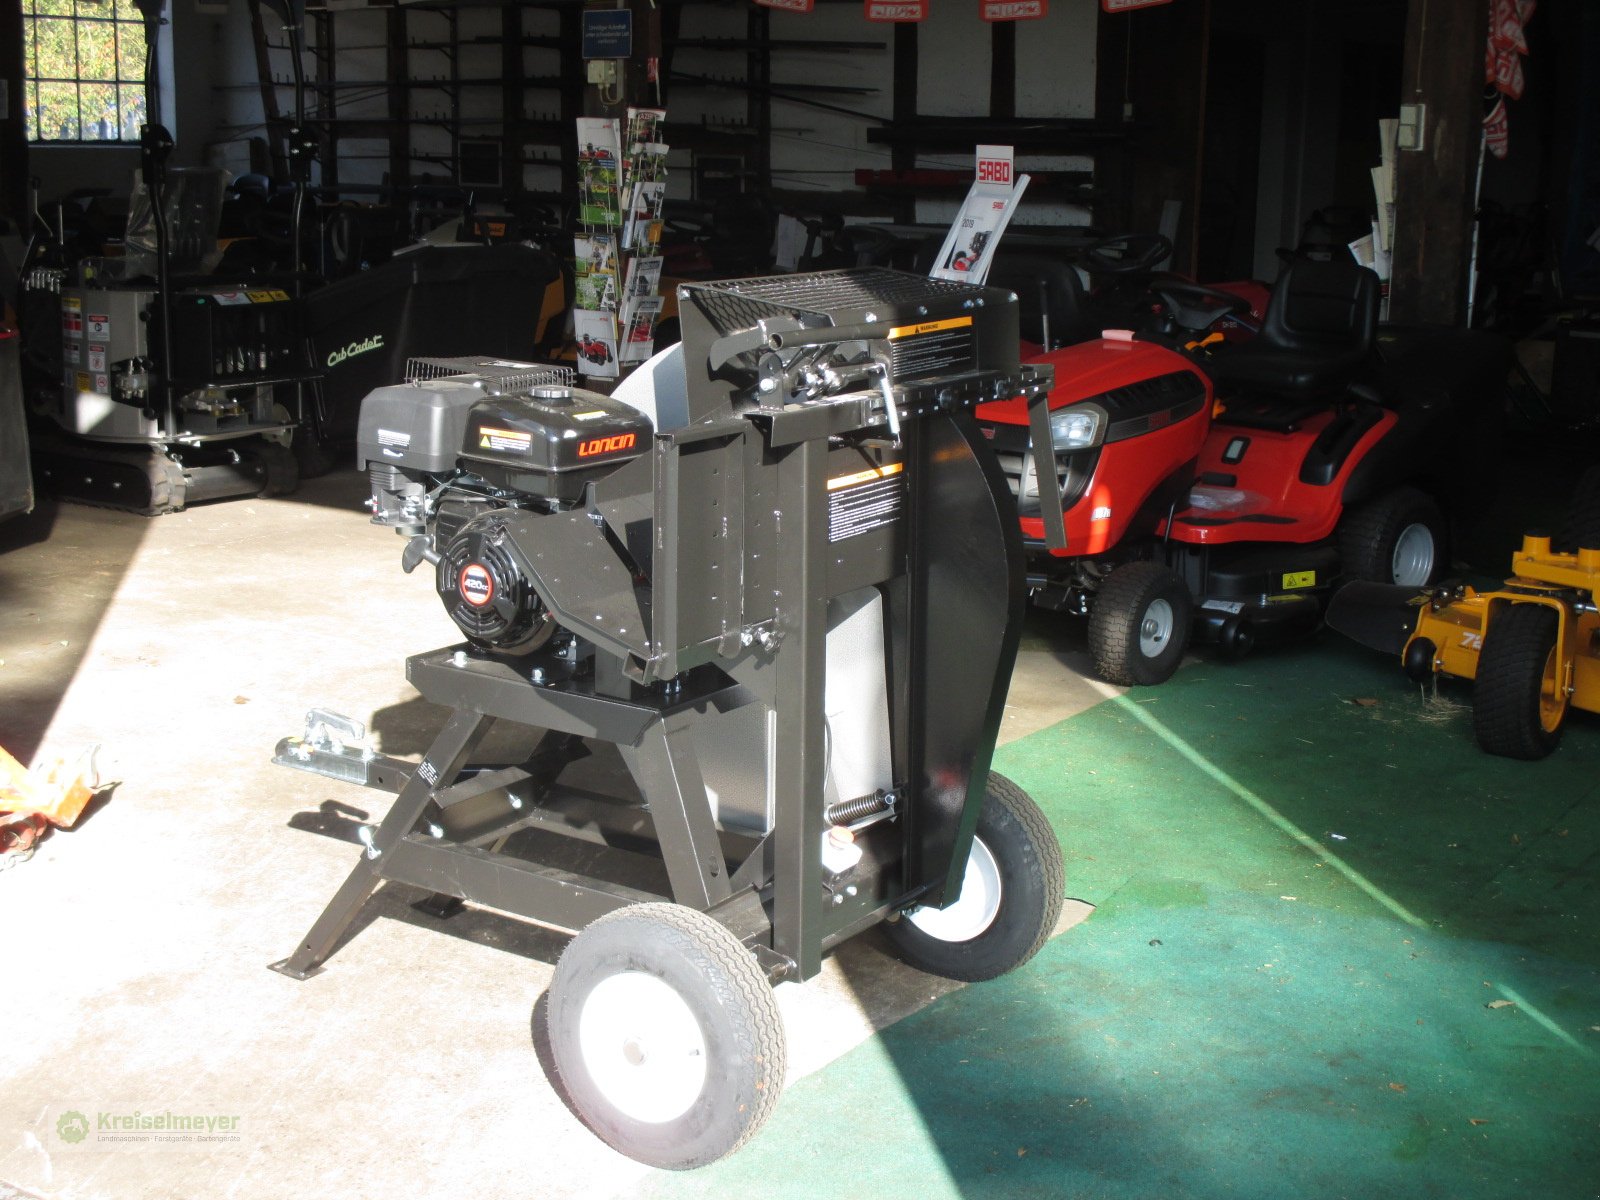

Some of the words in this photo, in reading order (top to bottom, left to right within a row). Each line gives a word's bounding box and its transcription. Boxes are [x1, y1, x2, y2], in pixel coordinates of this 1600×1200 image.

[978, 160, 1010, 182] SABO
[327, 347, 347, 367] Cub
[347, 335, 382, 357] Cadet
[578, 433, 635, 457] LONCIN
[464, 578, 489, 591] 420cc
